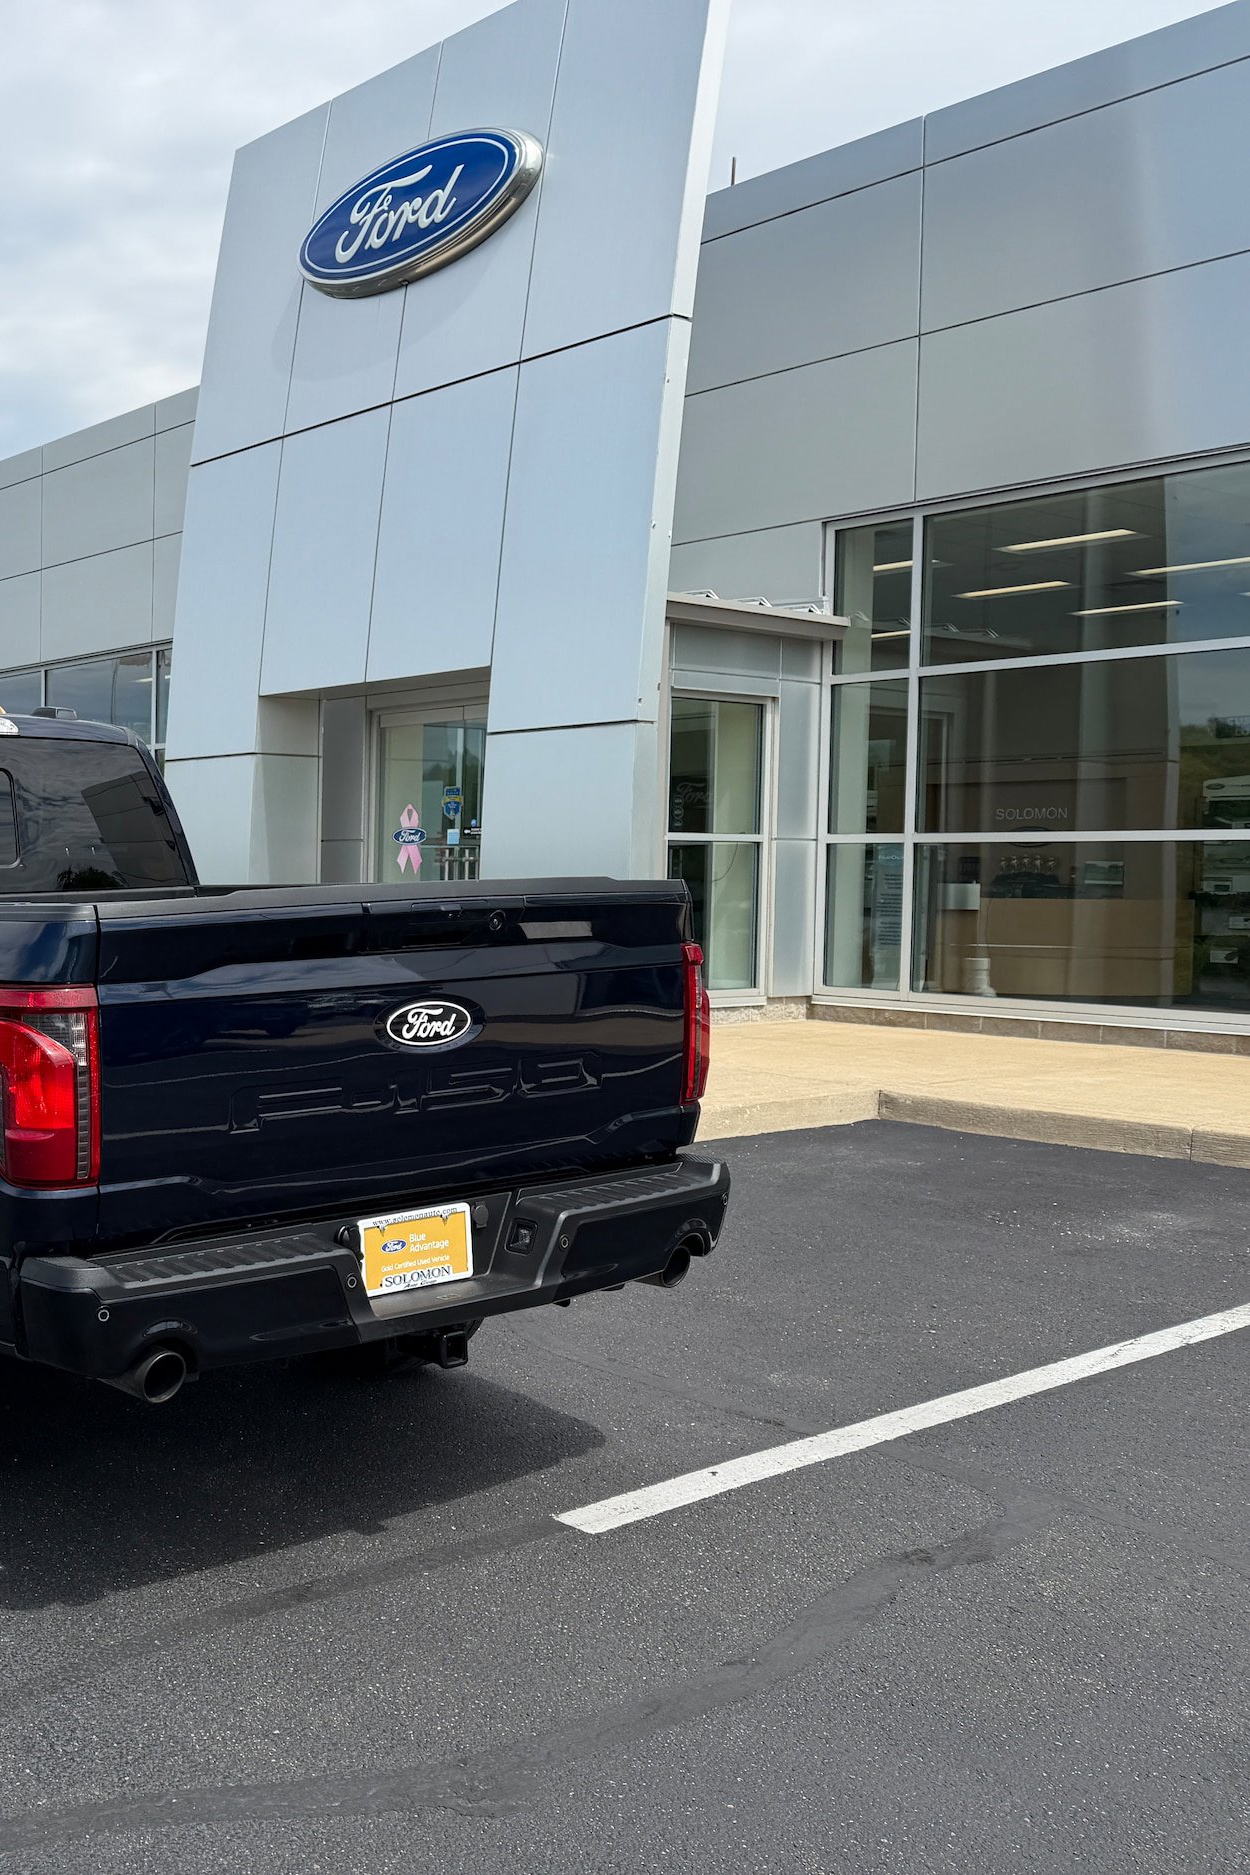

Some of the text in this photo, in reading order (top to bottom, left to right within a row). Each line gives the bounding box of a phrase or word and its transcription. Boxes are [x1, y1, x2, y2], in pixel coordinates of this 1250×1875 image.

[335, 164, 465, 264] Ford
[996, 807, 1068, 821] SOLOMON
[398, 830, 421, 842] Ford
[400, 1007, 457, 1040] Ford
[409, 1232, 427, 1243] Blue
[384, 1240, 403, 1253] Ford
[409, 1239, 450, 1253] Advantage
[394, 1260, 417, 1270] Certified
[417, 1258, 431, 1266] Used
[431, 1254, 450, 1263] Vehicle
[384, 1265, 452, 1288] SOLOMON
